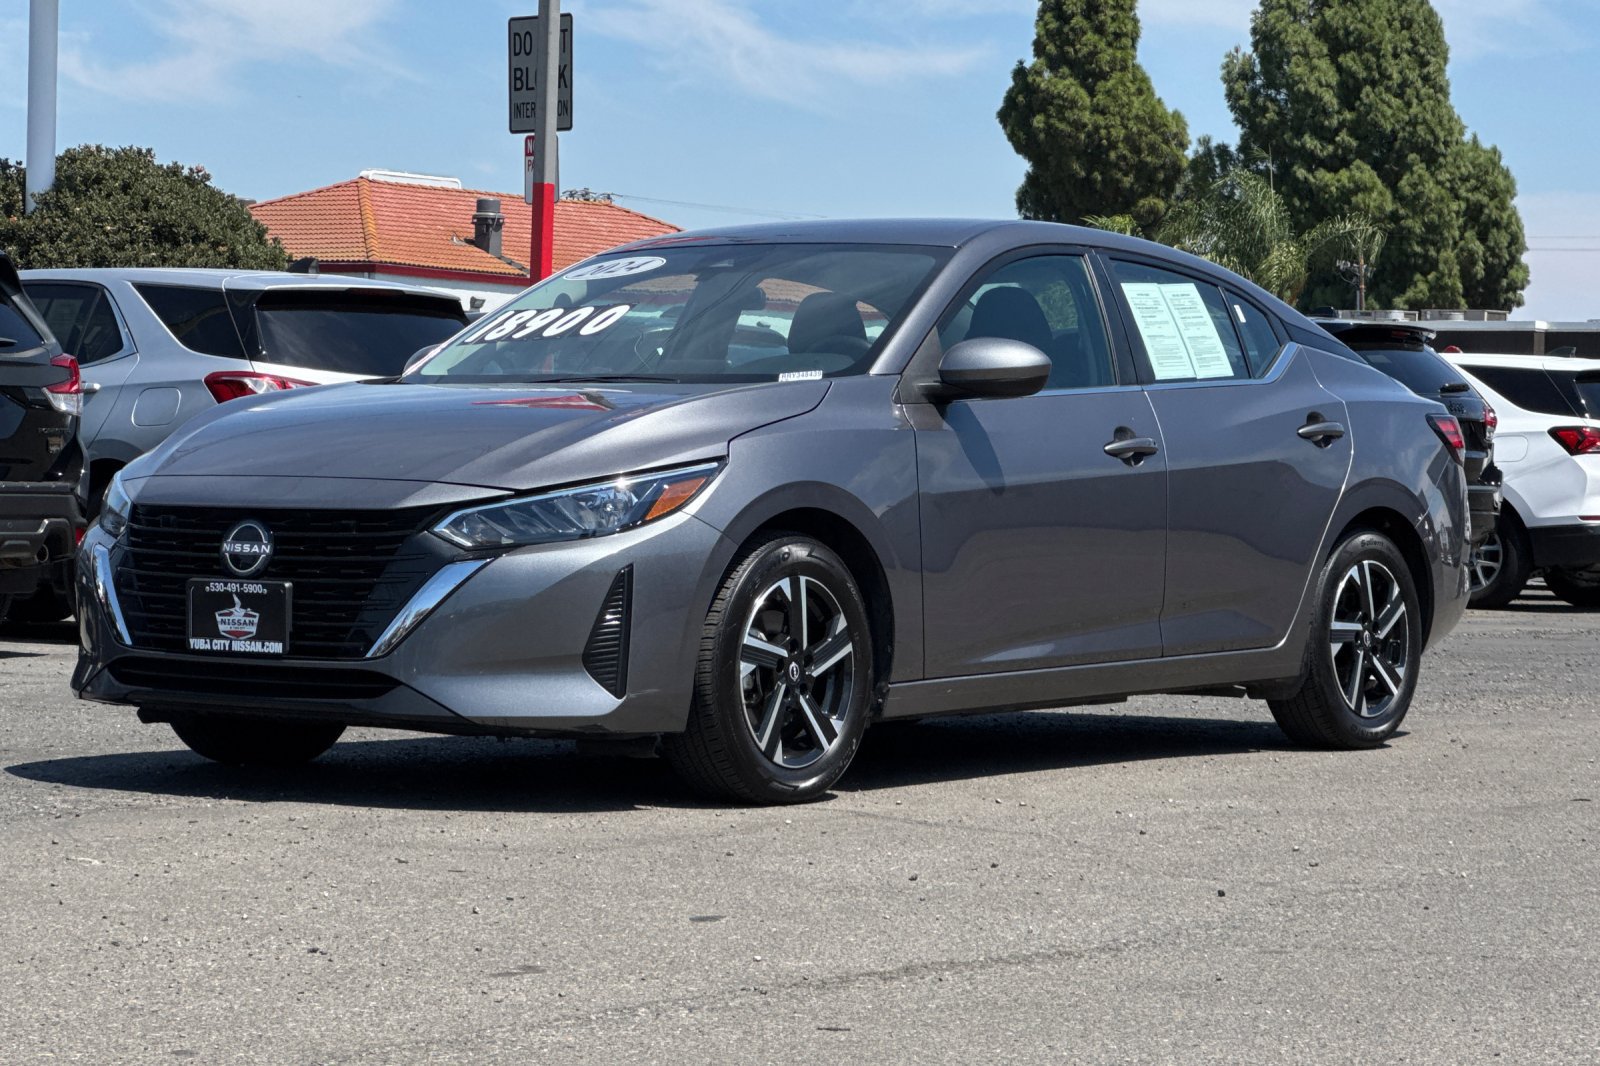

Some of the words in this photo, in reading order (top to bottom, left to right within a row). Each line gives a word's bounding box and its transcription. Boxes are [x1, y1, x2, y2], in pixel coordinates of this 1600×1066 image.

[513, 31, 533, 57] DO
[513, 64, 568, 92] BLK
[513, 101, 569, 119] INTERON
[573, 258, 655, 278] 2024
[464, 304, 631, 343] 18900
[222, 542, 271, 554] NISSAN
[209, 582, 263, 594] 530-491-5900
[220, 618, 255, 627] NISSAN
[189, 638, 211, 651] YUBA
[212, 639, 230, 651] CITY
[231, 640, 283, 654] NISSAN.COM
